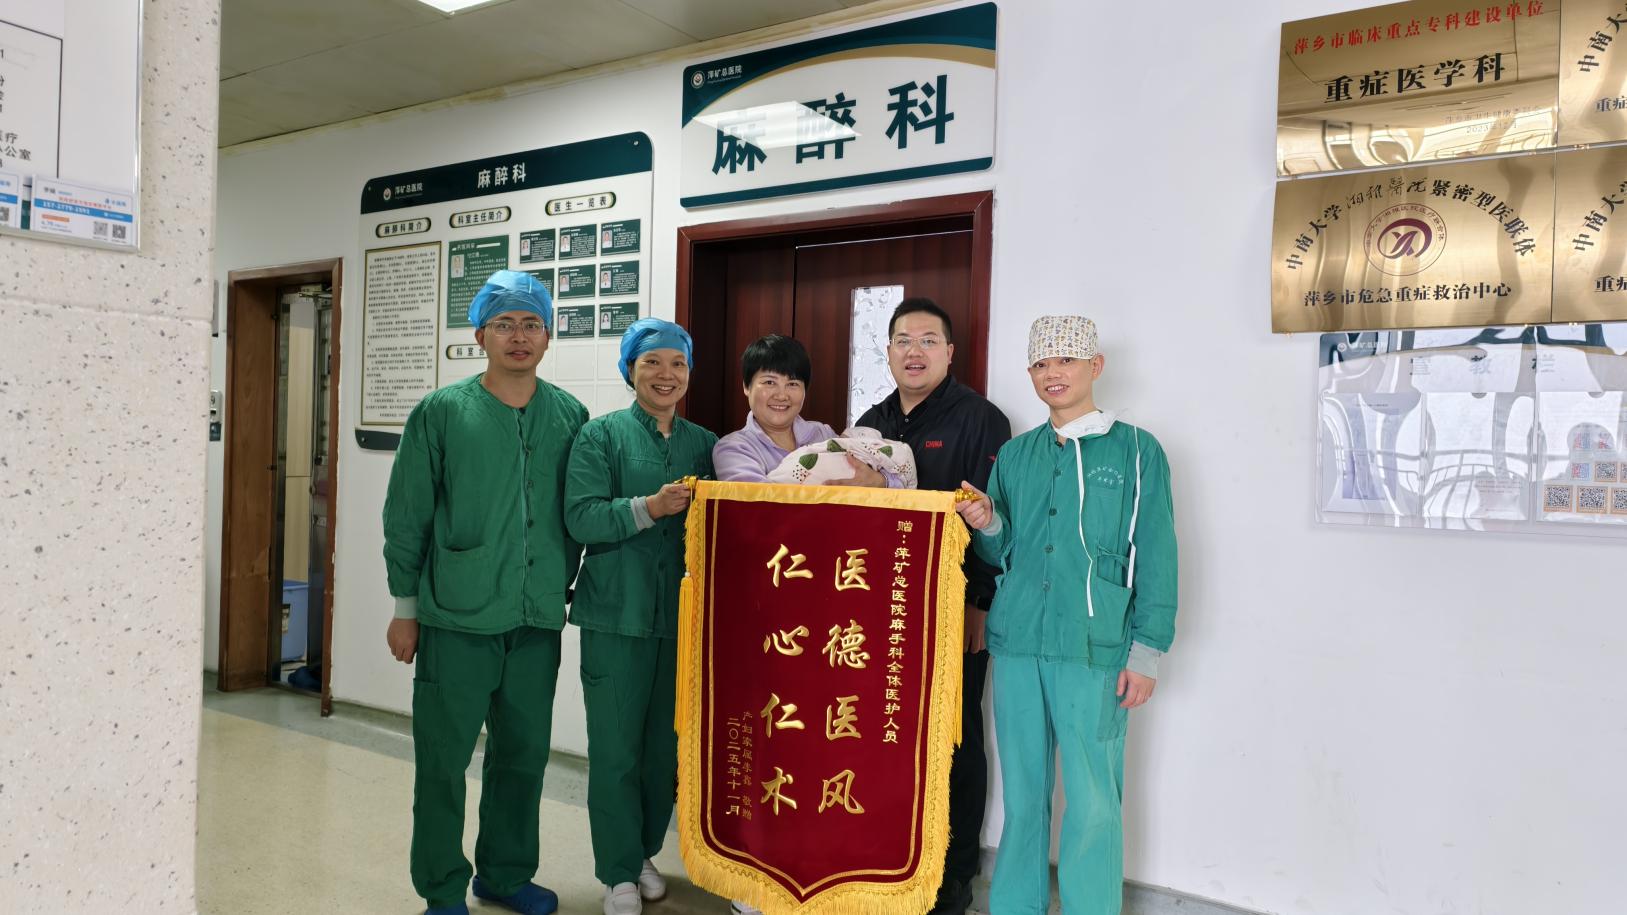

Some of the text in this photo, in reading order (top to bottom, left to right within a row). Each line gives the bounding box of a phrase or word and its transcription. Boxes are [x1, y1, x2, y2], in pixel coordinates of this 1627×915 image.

[1294, 0, 1545, 55] 萍乡市临床重点专科建设单位
[1577, 2, 1627, 72] 中南大
[707, 64, 743, 80] 萍矿总医院
[1323, 52, 1506, 103] 重症医学科
[712, 74, 954, 176] 麻醉科
[477, 162, 527, 188] 麻醉科
[457, 210, 503, 225] 科室主任简介
[554, 196, 607, 212] 医生一览表
[1304, 283, 1512, 306] 萍乡市危急重症救治中心
[925, 440, 943, 448] CHINA
[760, 543, 814, 816] 仁心仁术
[818, 548, 871, 814] 医德医风
